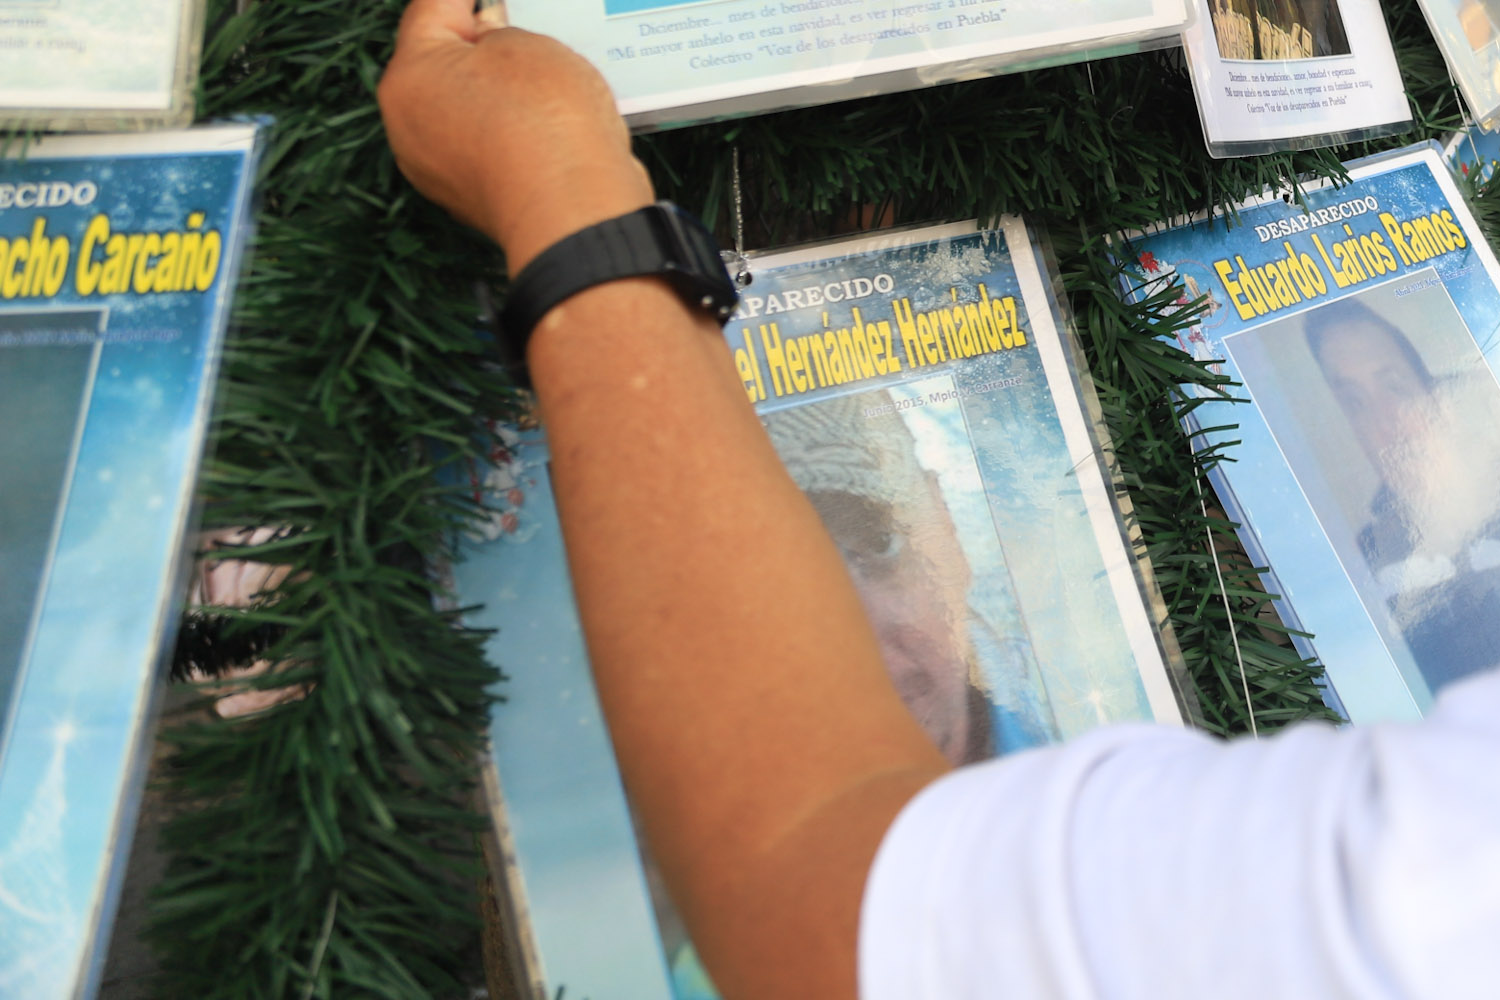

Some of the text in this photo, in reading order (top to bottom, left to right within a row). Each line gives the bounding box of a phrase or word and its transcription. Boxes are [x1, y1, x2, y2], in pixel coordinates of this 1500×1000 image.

[640, 41, 683, 58] mayor
[687, 30, 735, 50] anhelo
[738, 29, 756, 42] en
[759, 23, 784, 38] esta
[788, 13, 846, 33] navidad,
[850, 12, 863, 24] es
[866, 8, 887, 21] ver
[891, 0, 942, 19] regresar
[947, 0, 956, 9] a
[728, 10, 756, 23] mes
[760, 4, 776, 18] de
[689, 50, 753, 70] Colectivo
[796, 39, 812, 54] de
[816, 35, 836, 50] los
[840, 20, 930, 47] desaparecidos
[936, 18, 952, 31] en
[1254, 195, 1380, 243] DESAPARECIDO
[75, 211, 222, 296] Carcaño
[1213, 208, 1467, 321] Eduardo Larios Ramos
[759, 306, 901, 397] Hernández
[892, 283, 1027, 369] Hernández
[863, 403, 893, 418] Junio
[895, 395, 928, 413] 2015,
[974, 375, 1023, 394] Carranza
